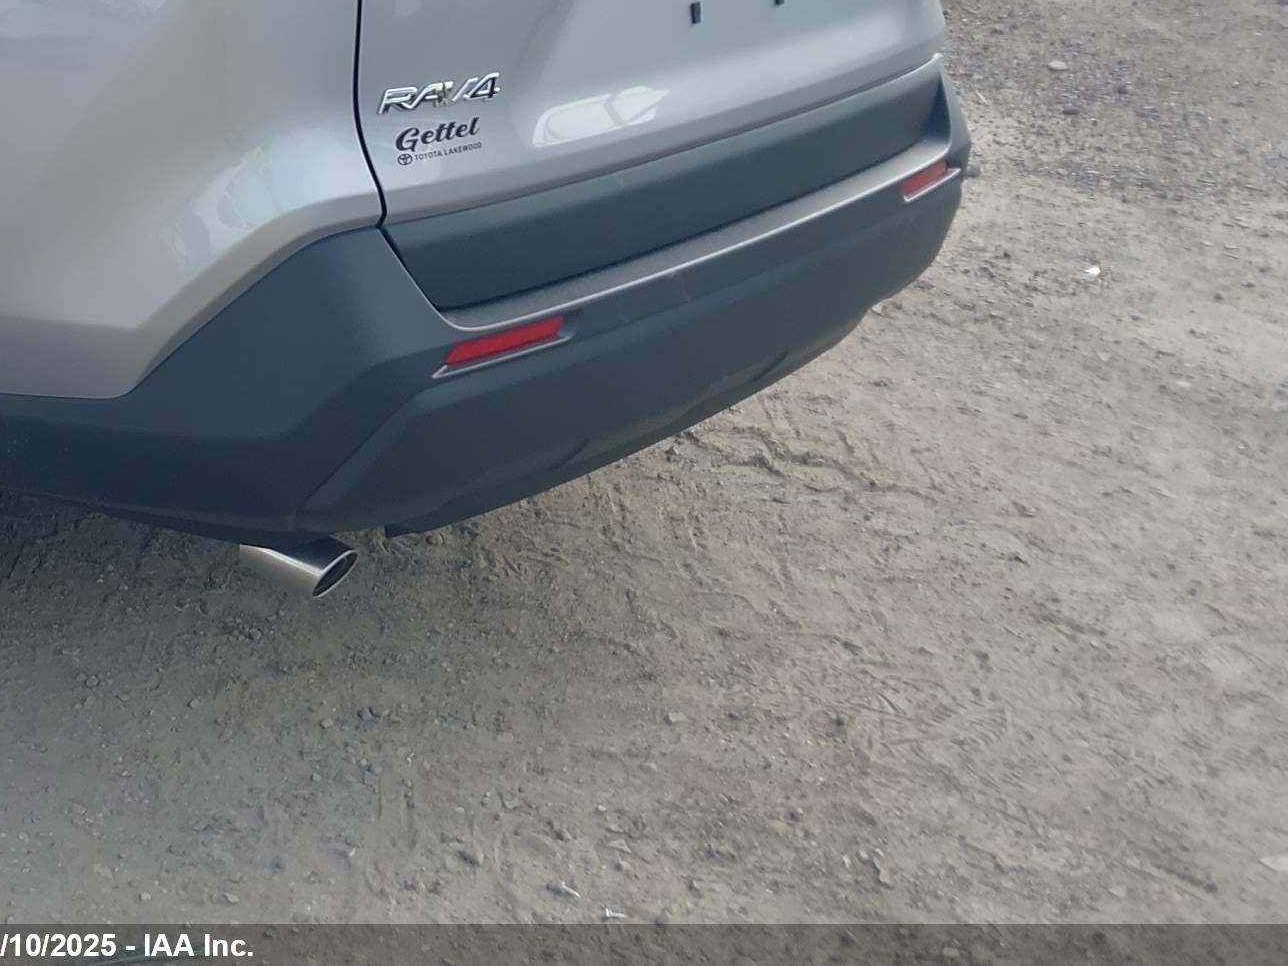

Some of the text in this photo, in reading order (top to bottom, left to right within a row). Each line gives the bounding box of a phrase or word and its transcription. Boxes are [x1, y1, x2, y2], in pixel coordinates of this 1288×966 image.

[377, 71, 501, 115] RAV4
[395, 116, 480, 152] Gettel
[414, 141, 482, 161] TOYOTA LAKEWOOD
